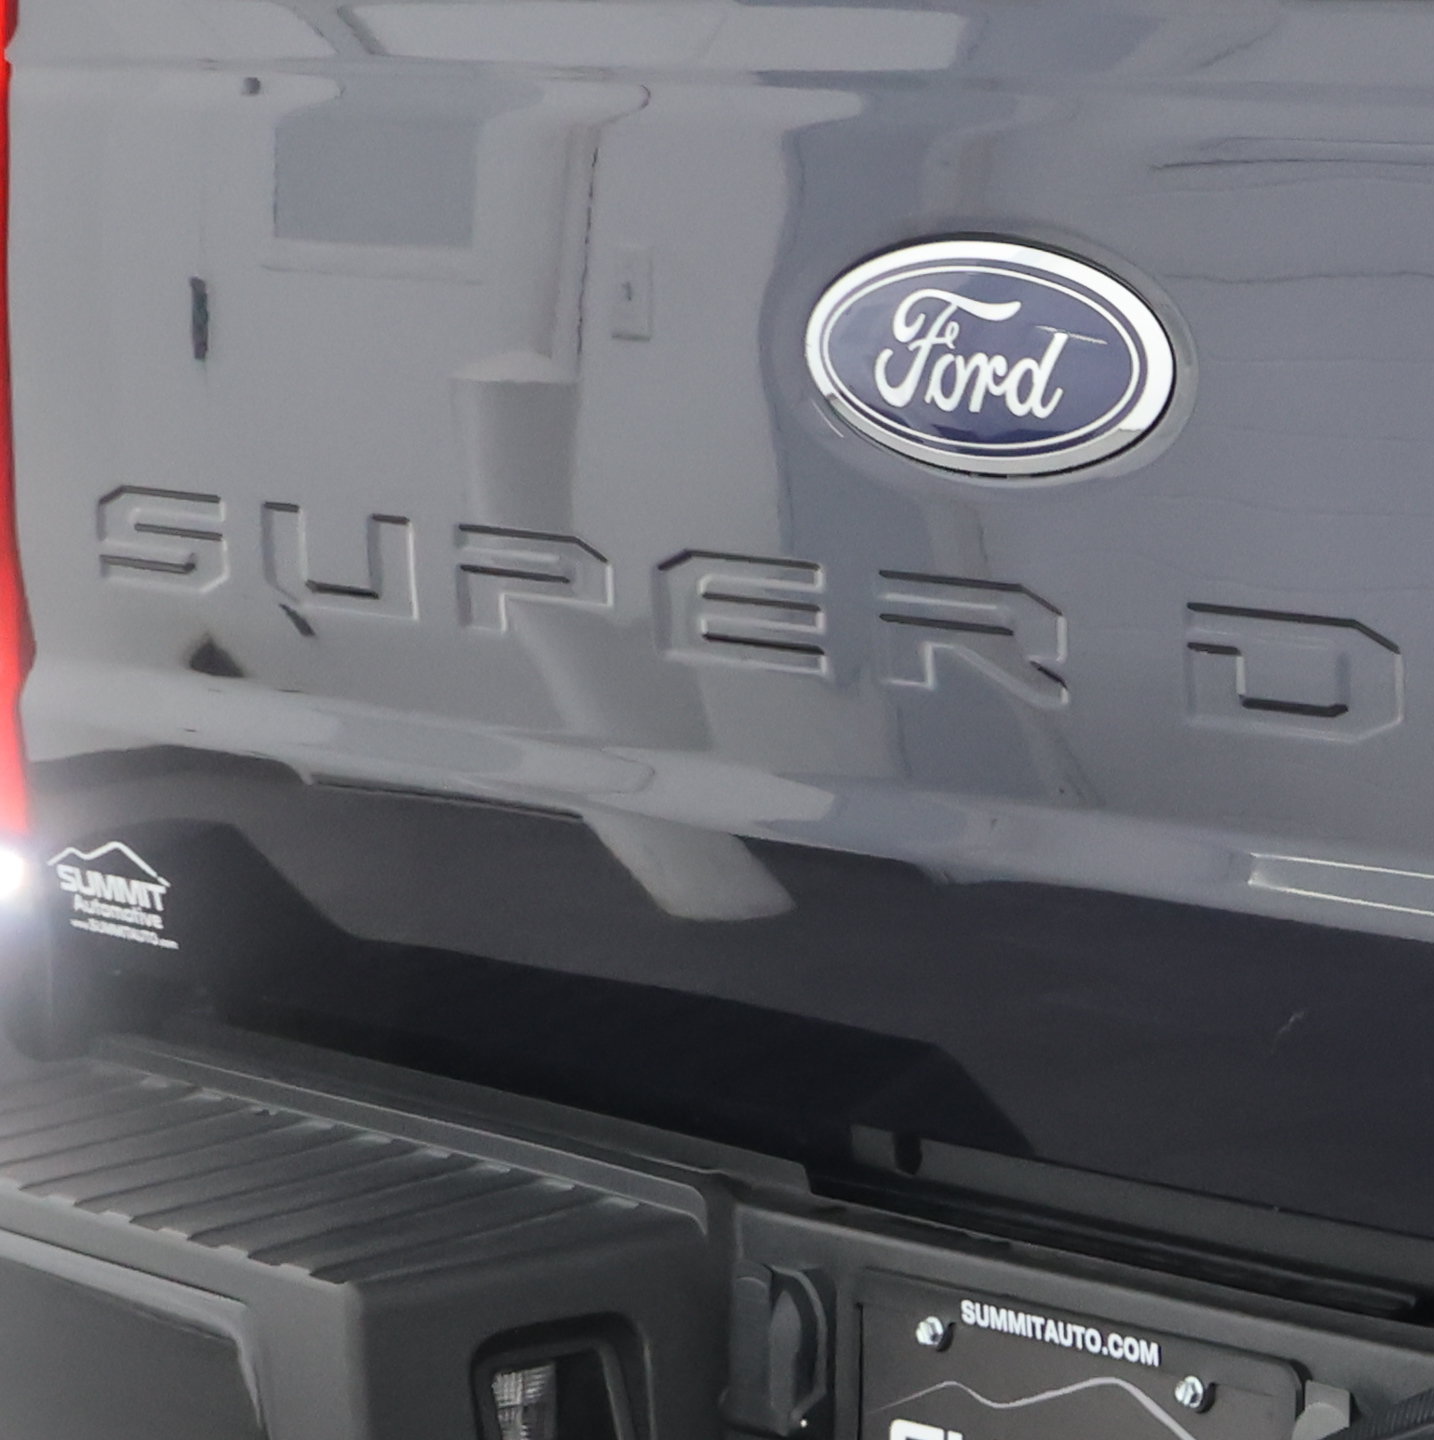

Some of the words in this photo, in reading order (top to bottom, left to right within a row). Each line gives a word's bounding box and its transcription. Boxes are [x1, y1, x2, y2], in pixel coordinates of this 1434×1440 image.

[874, 288, 1064, 420] Ford
[96, 484, 1070, 706] SUPER
[56, 863, 168, 912] SUMMIT
[73, 894, 165, 930] Automotive
[960, 1299, 1160, 1368] SUMMITAUTO.COM
